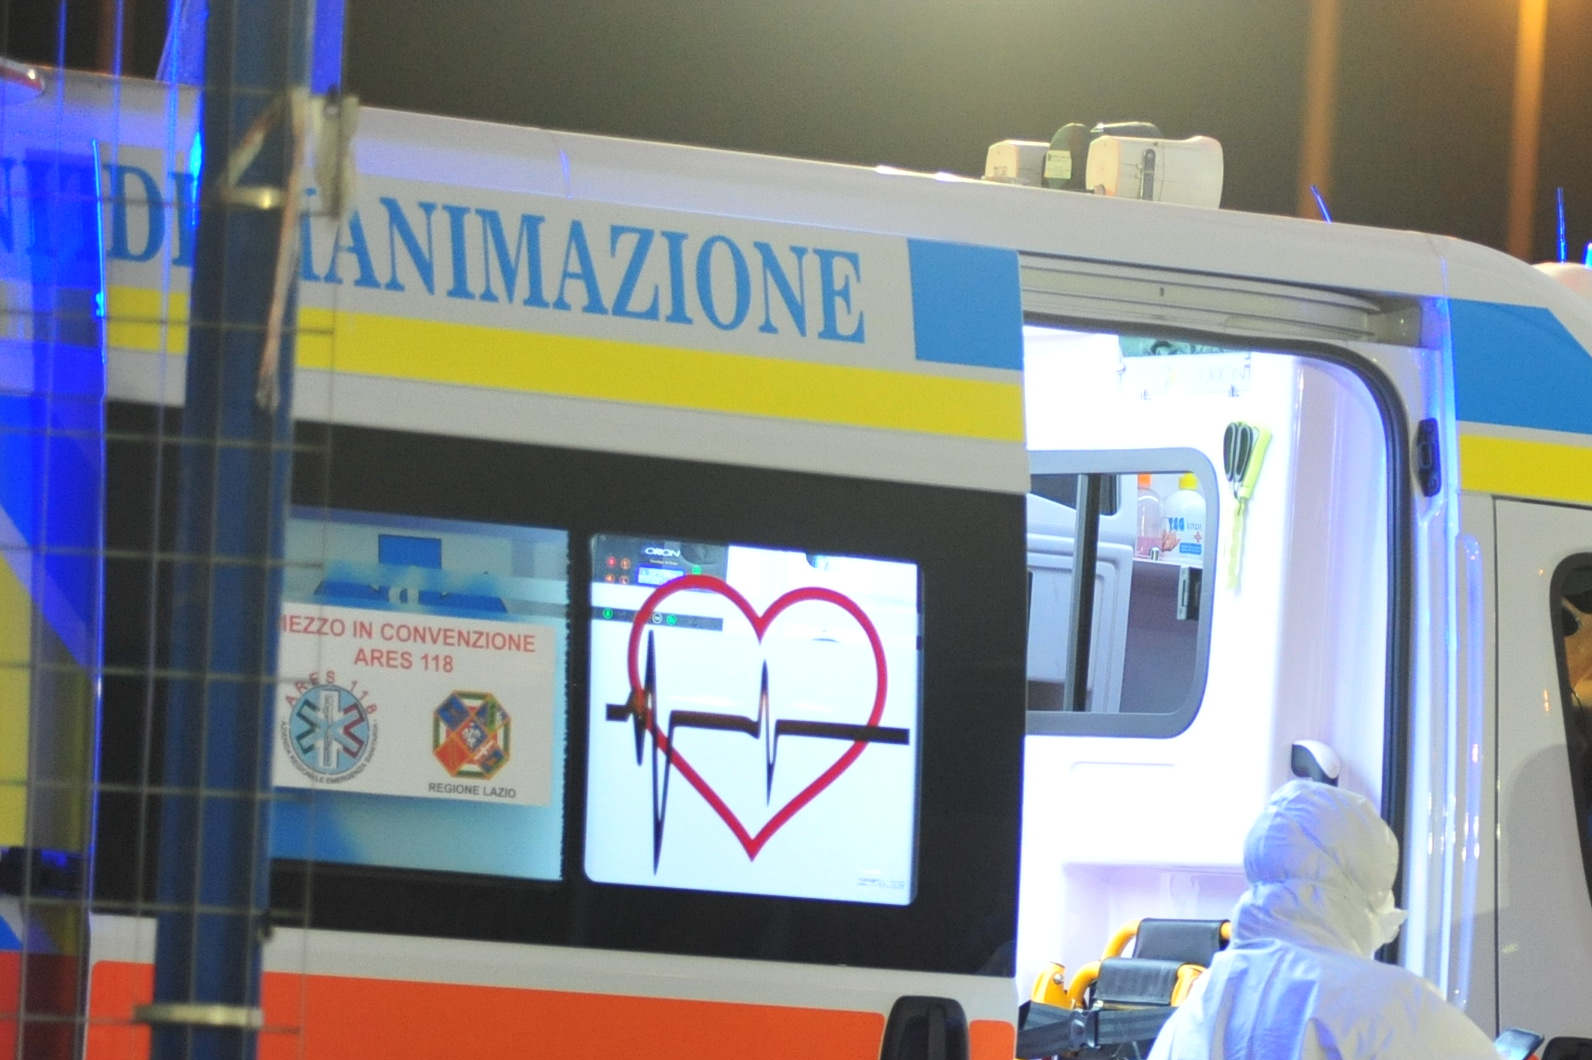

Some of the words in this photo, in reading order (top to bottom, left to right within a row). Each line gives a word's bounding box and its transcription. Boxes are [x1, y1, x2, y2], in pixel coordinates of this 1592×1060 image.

[297, 187, 866, 344] IANIMAZIONE
[282, 615, 345, 637] EZZO
[353, 621, 373, 640] IN
[380, 623, 536, 653] CONVENZIONE
[354, 648, 413, 669] ARES
[420, 653, 454, 673] 118
[286, 670, 336, 708] ARES
[428, 782, 480, 796] REGIONE
[482, 785, 516, 799] LAZIO
